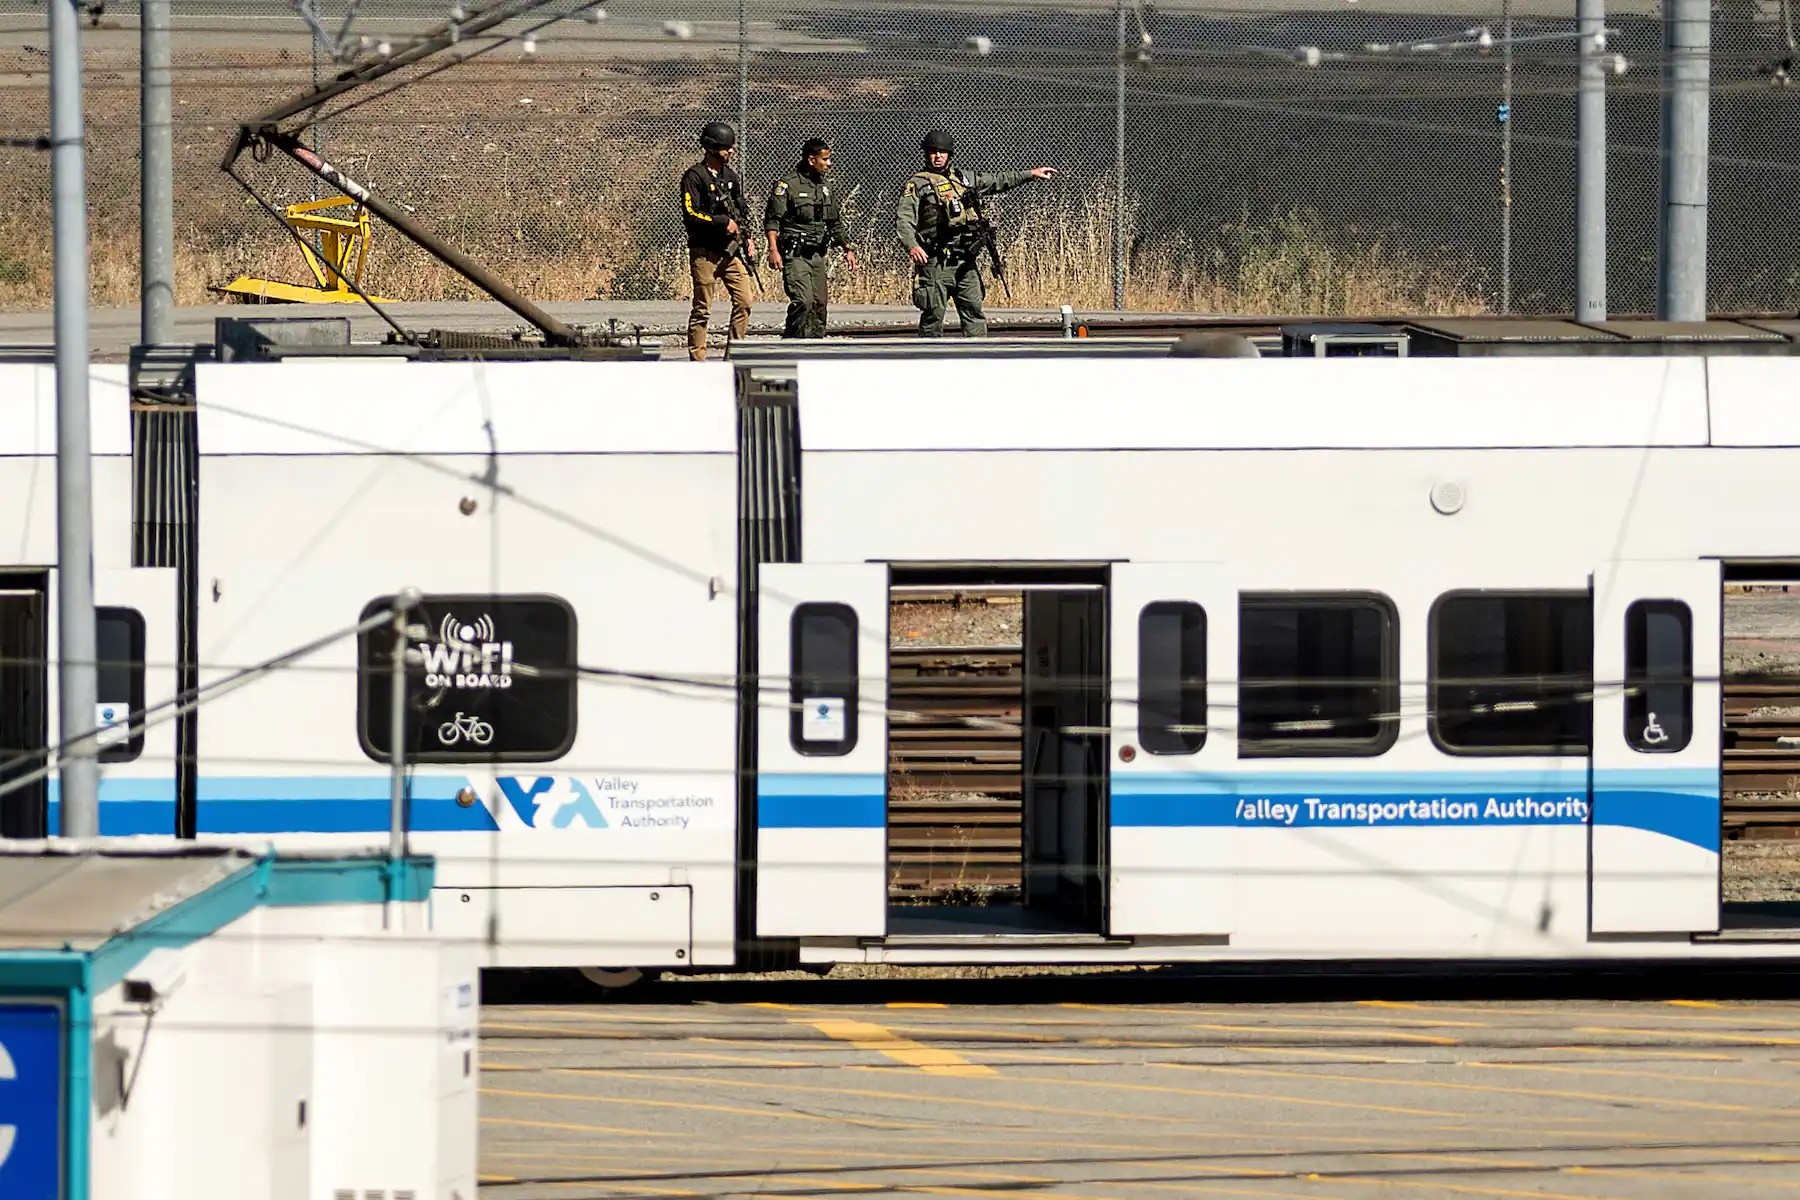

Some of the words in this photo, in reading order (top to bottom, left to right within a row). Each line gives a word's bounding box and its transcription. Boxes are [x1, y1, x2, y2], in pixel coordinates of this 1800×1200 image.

[425, 674, 452, 688] ON
[456, 674, 512, 689] BOARD
[595, 777, 638, 794] Valley
[608, 795, 714, 811] Transportation
[1303, 798, 1478, 824] Transportation
[1483, 796, 1590, 823] Authority
[621, 814, 690, 829] Authority
